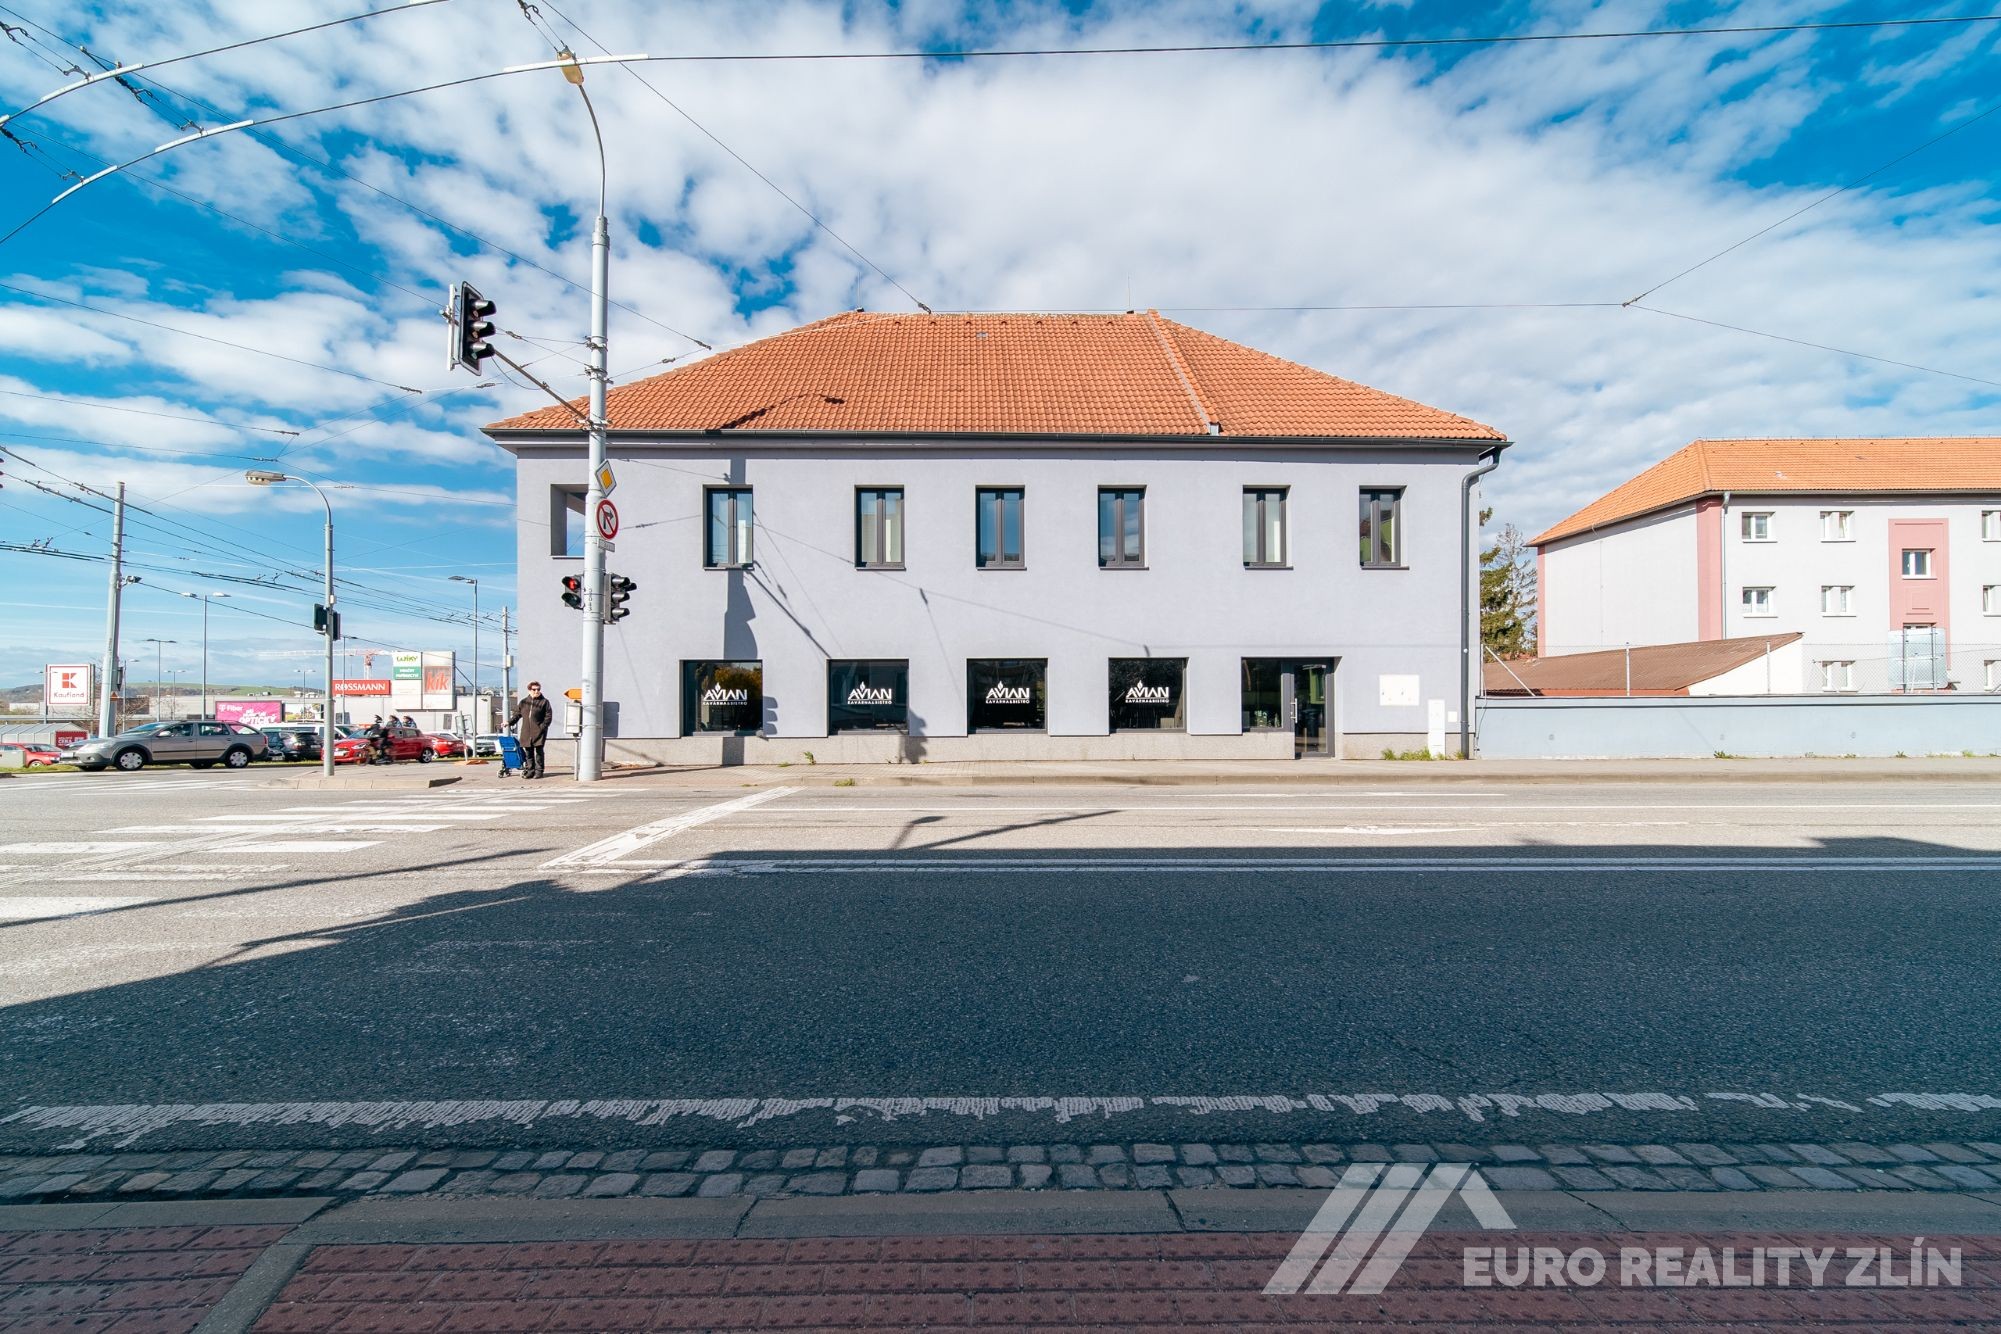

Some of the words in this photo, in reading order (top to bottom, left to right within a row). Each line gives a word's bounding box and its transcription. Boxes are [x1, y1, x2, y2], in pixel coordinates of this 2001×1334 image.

[425, 671, 449, 690] kik
[335, 682, 386, 691] ROSSMANN
[1125, 686, 1169, 697] AVIAN
[703, 689, 748, 700] AVIAN
[847, 688, 892, 700] AVIAN
[985, 687, 1030, 698] AVIAN
